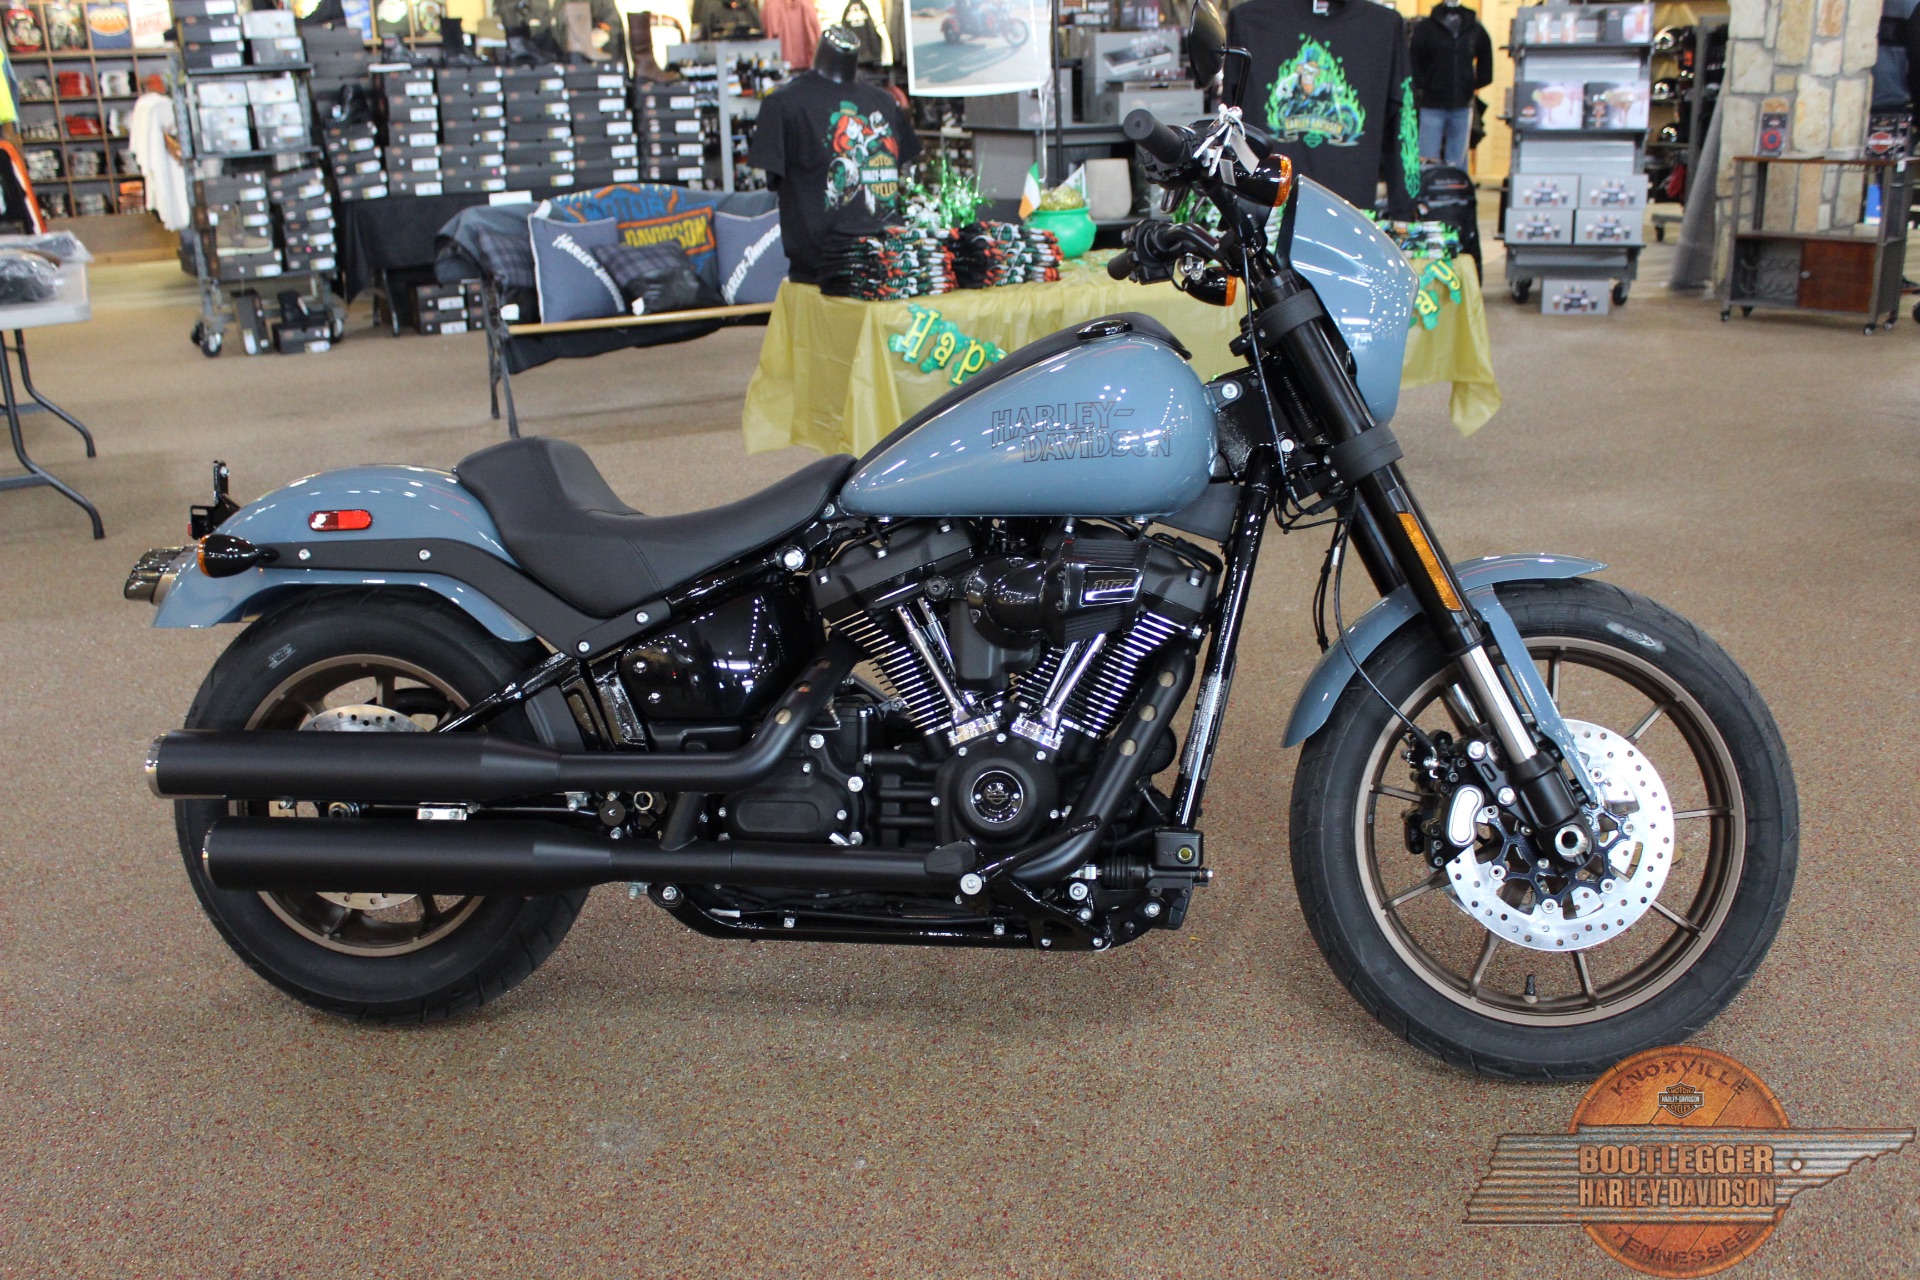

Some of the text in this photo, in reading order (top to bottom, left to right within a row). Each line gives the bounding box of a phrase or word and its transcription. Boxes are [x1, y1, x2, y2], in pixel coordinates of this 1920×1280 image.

[721, 224, 782, 305] HARLEY-DAVIDSO
[1022, 428, 1171, 463] DAVIDSON
[1093, 578, 1133, 591] 117
